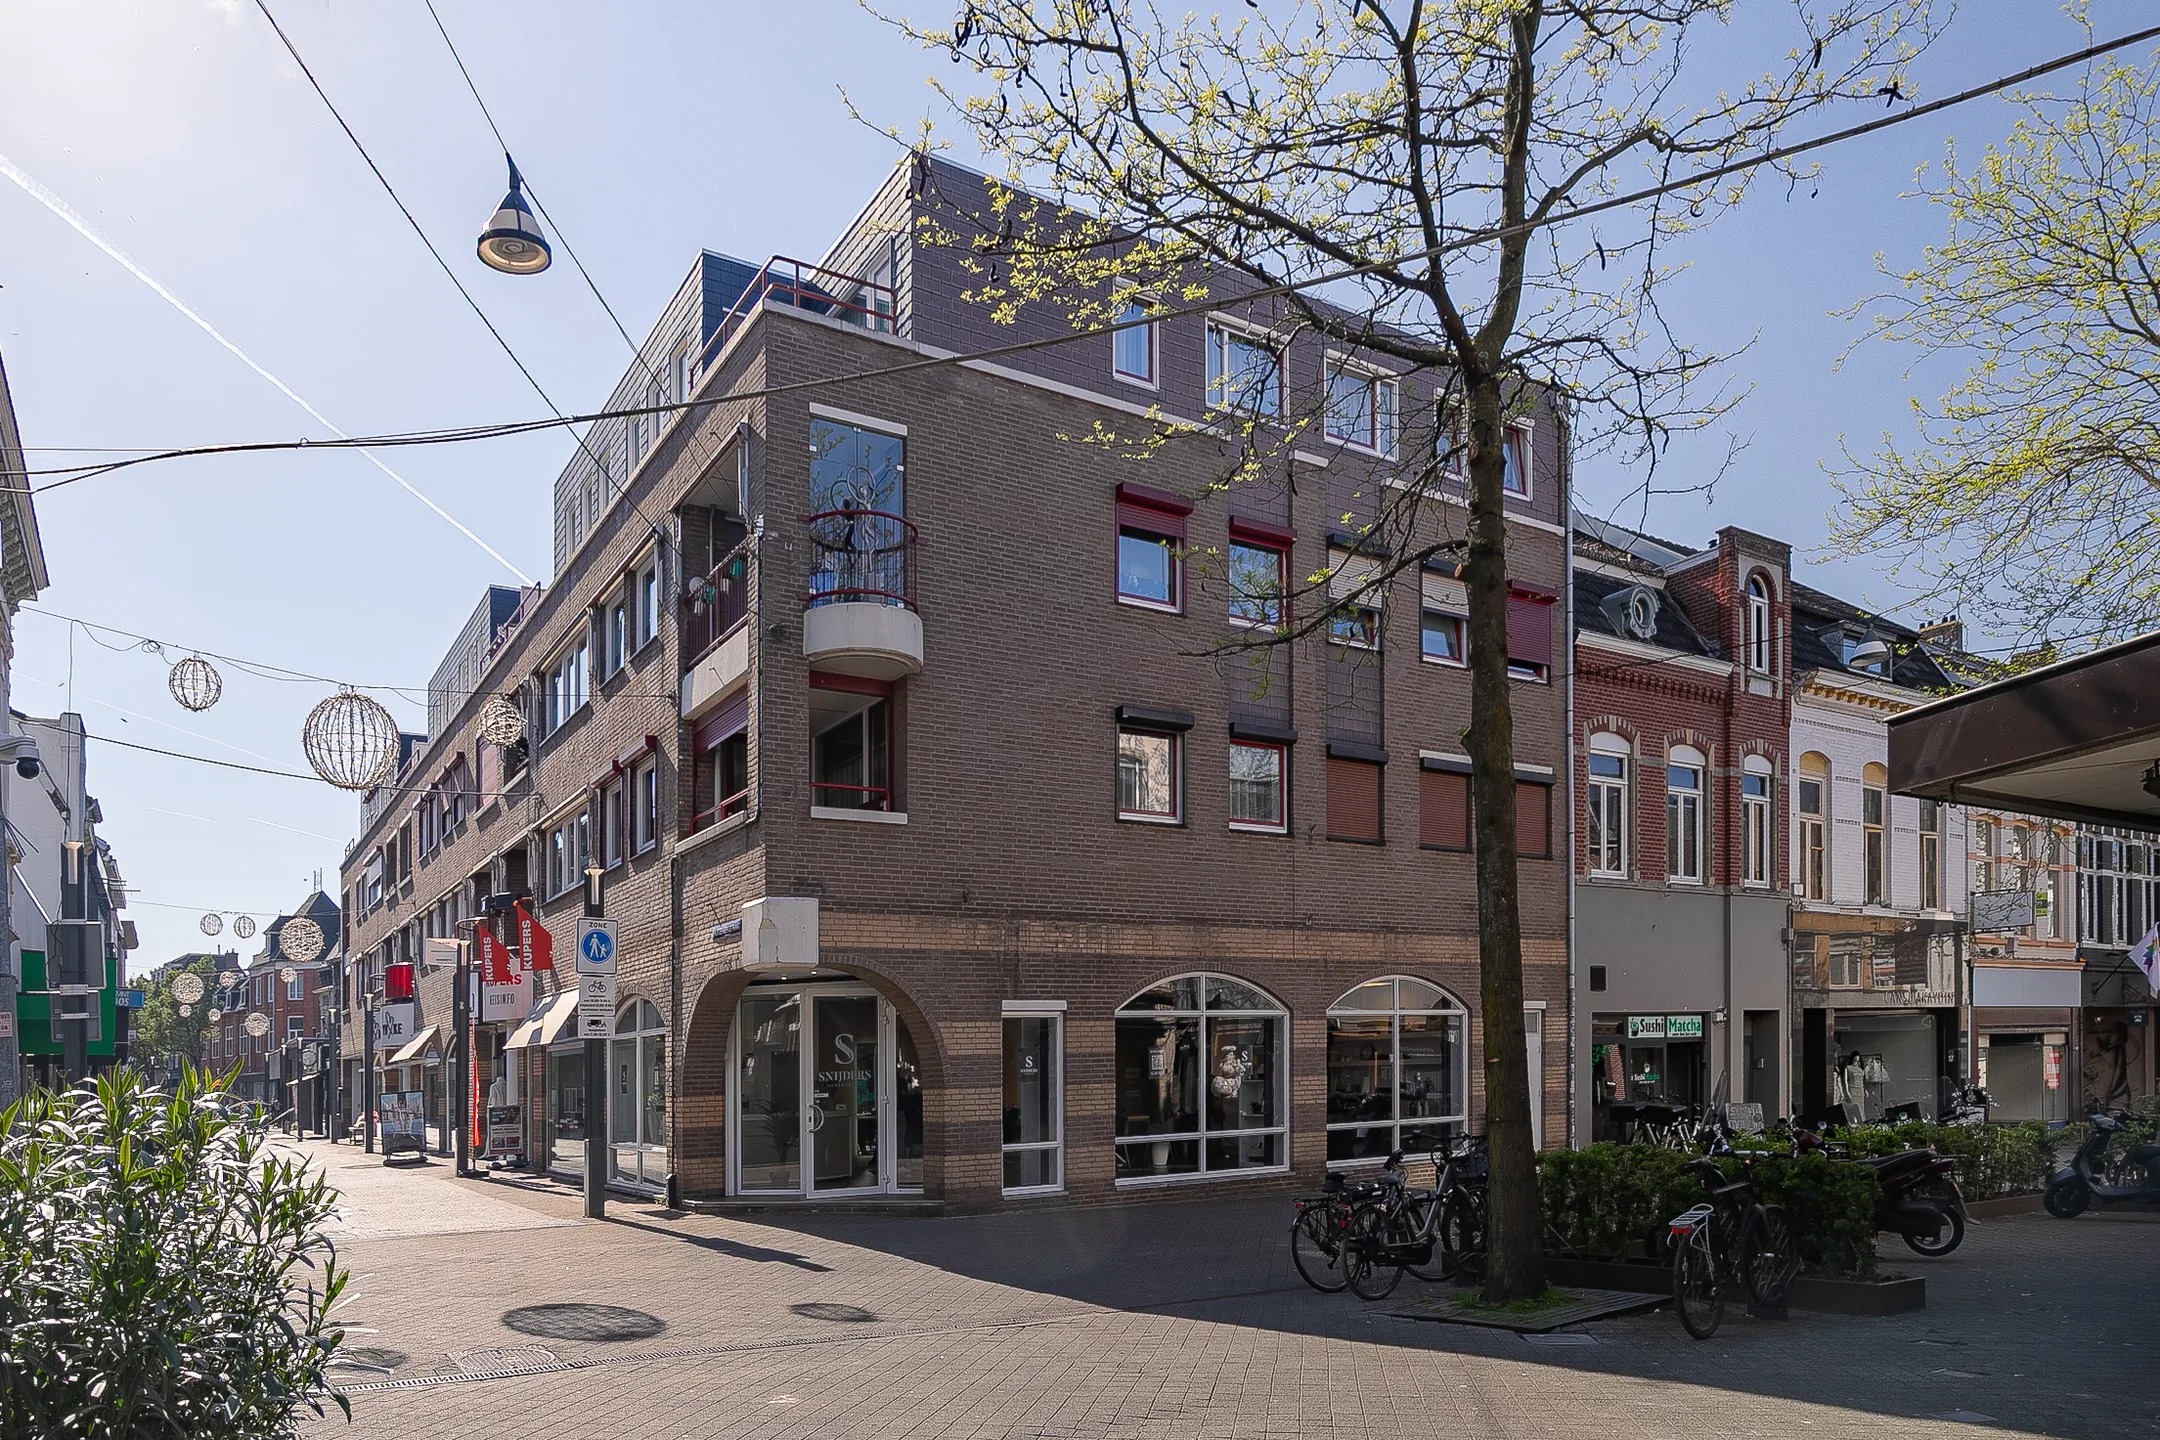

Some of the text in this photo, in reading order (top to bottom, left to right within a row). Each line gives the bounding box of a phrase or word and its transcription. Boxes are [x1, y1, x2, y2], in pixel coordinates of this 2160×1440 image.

[522, 920, 533, 969] KUPERS
[483, 937, 494, 981] KUPERS
[1640, 1018, 1664, 1033] Sushi
[1668, 1018, 1701, 1032] Matcha
[835, 1033, 855, 1065] S
[1025, 1055, 1033, 1068] S
[818, 1069, 872, 1082] SNIJDERS
